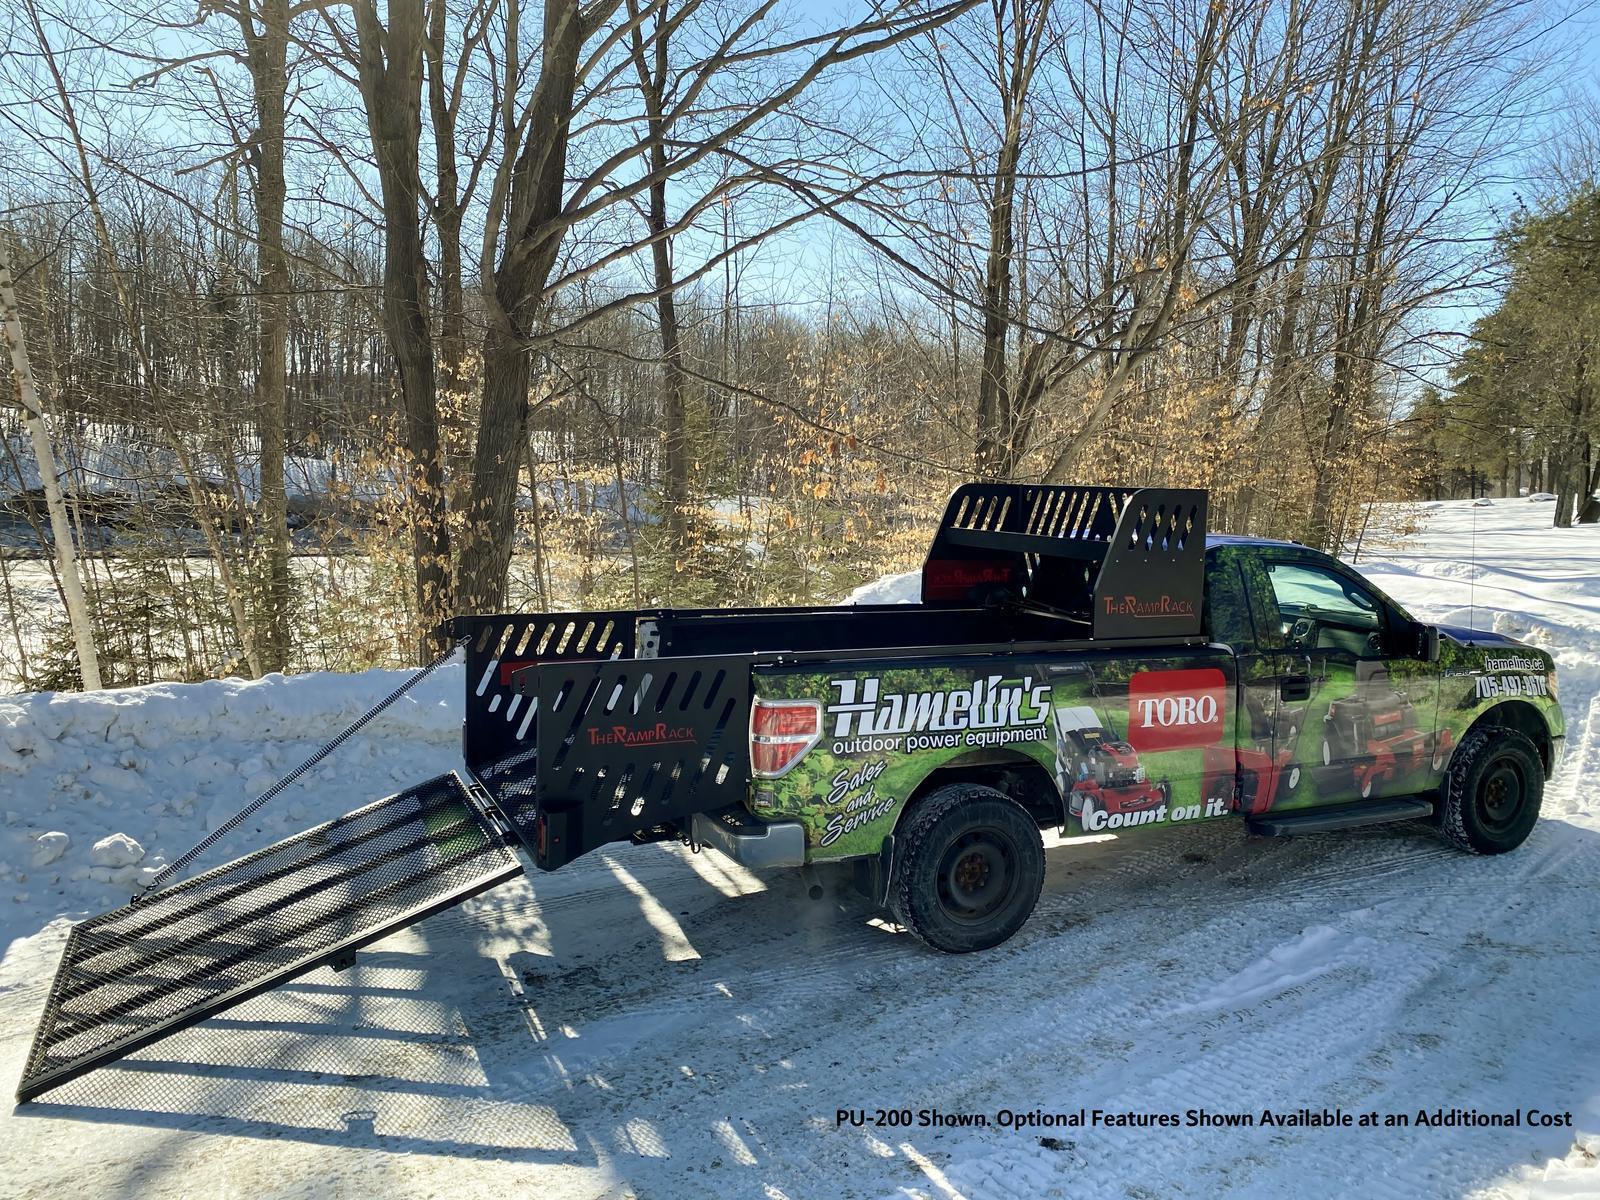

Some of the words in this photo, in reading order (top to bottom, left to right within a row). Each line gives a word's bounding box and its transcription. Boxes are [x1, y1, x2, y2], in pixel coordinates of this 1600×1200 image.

[1485, 656, 1544, 670] hamelins.ca
[827, 675, 1051, 737] Hamelin's
[1138, 695, 1218, 728] TORO
[833, 735, 902, 754] outdoor
[906, 734, 961, 752] power
[965, 727, 1048, 750] equipment
[828, 761, 886, 804] Sales
[846, 784, 875, 813] and
[820, 798, 896, 846] Service
[1089, 803, 1168, 831] Count
[1171, 804, 1200, 820] on
[1204, 798, 1229, 818] it.
